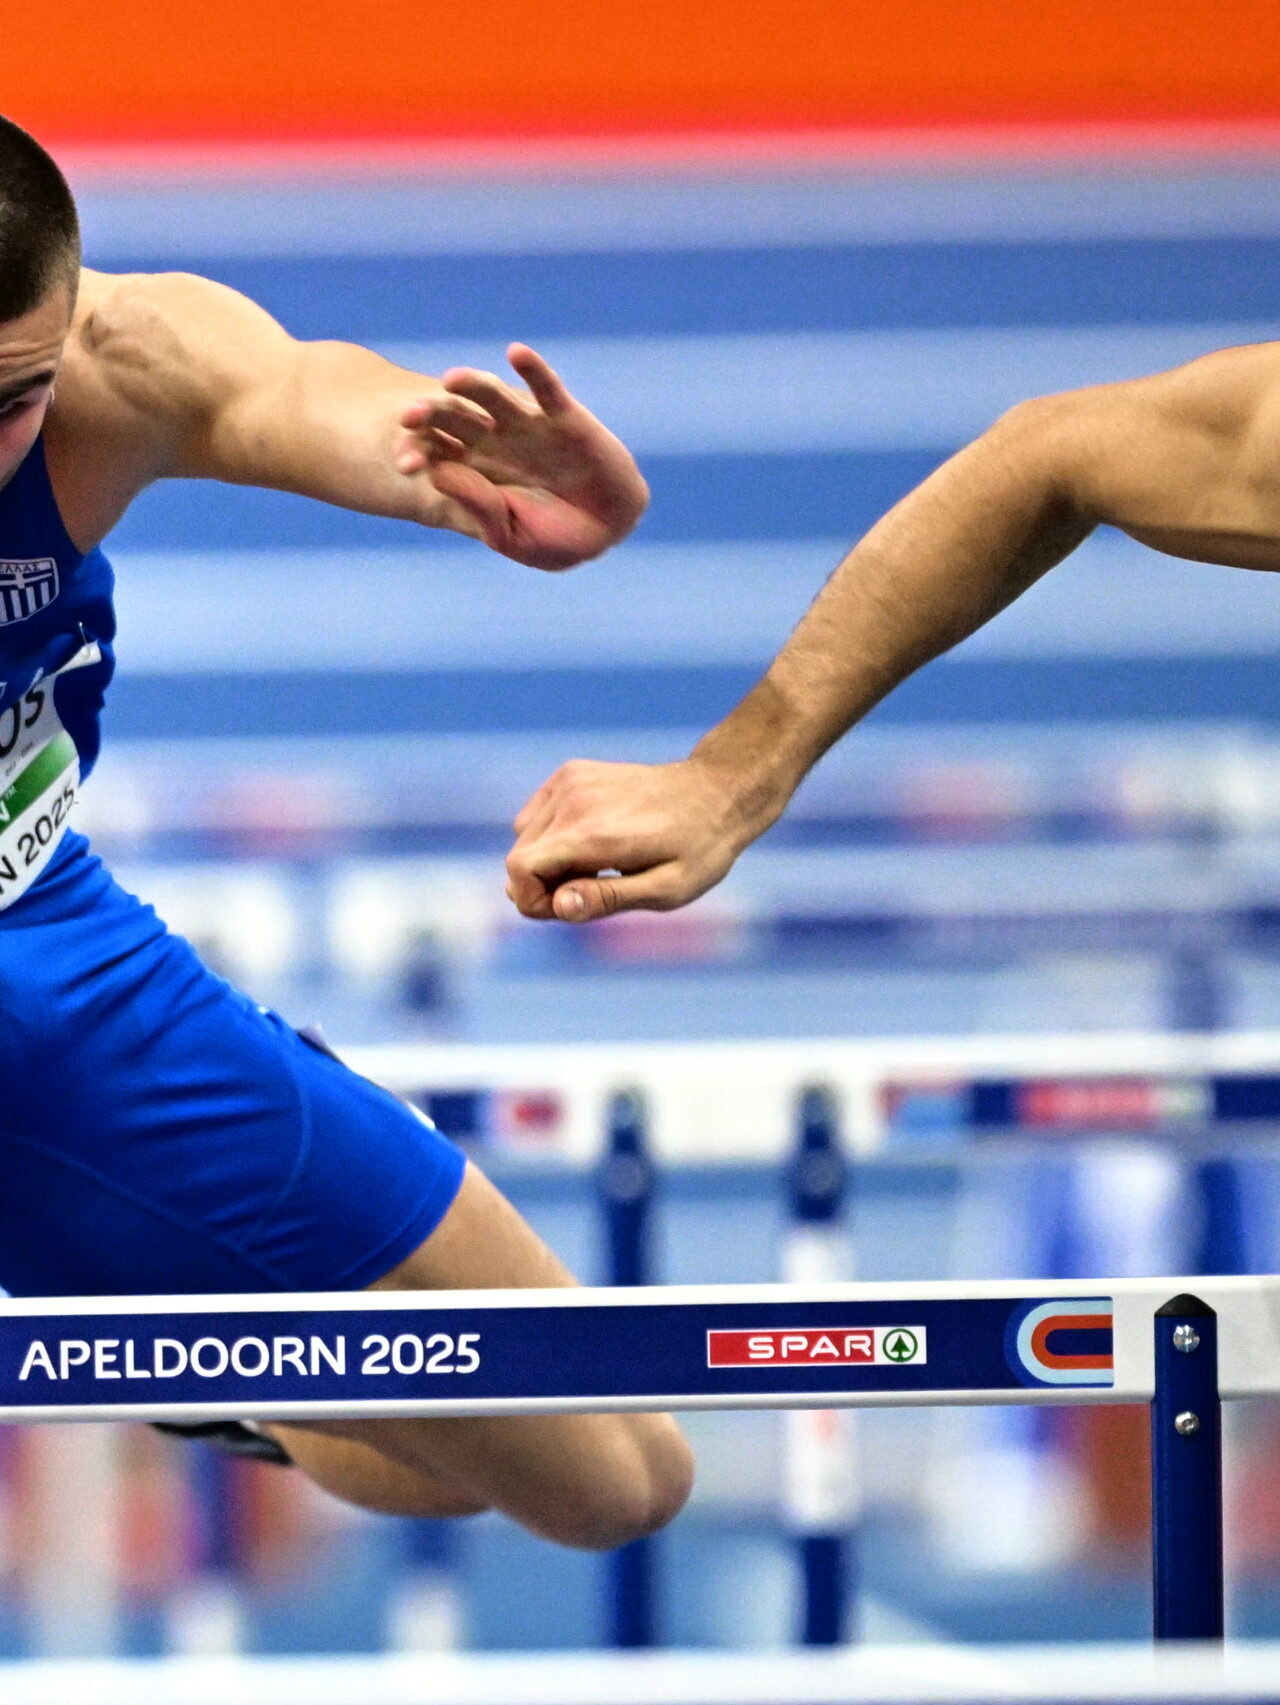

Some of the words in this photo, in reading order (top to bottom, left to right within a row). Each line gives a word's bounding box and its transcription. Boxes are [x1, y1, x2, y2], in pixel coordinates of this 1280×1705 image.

[17, 786, 75, 867] 2025
[18, 1335, 346, 1381] APELDOORN
[360, 1333, 481, 1376] 2025
[747, 1334, 872, 1360] SPAR
